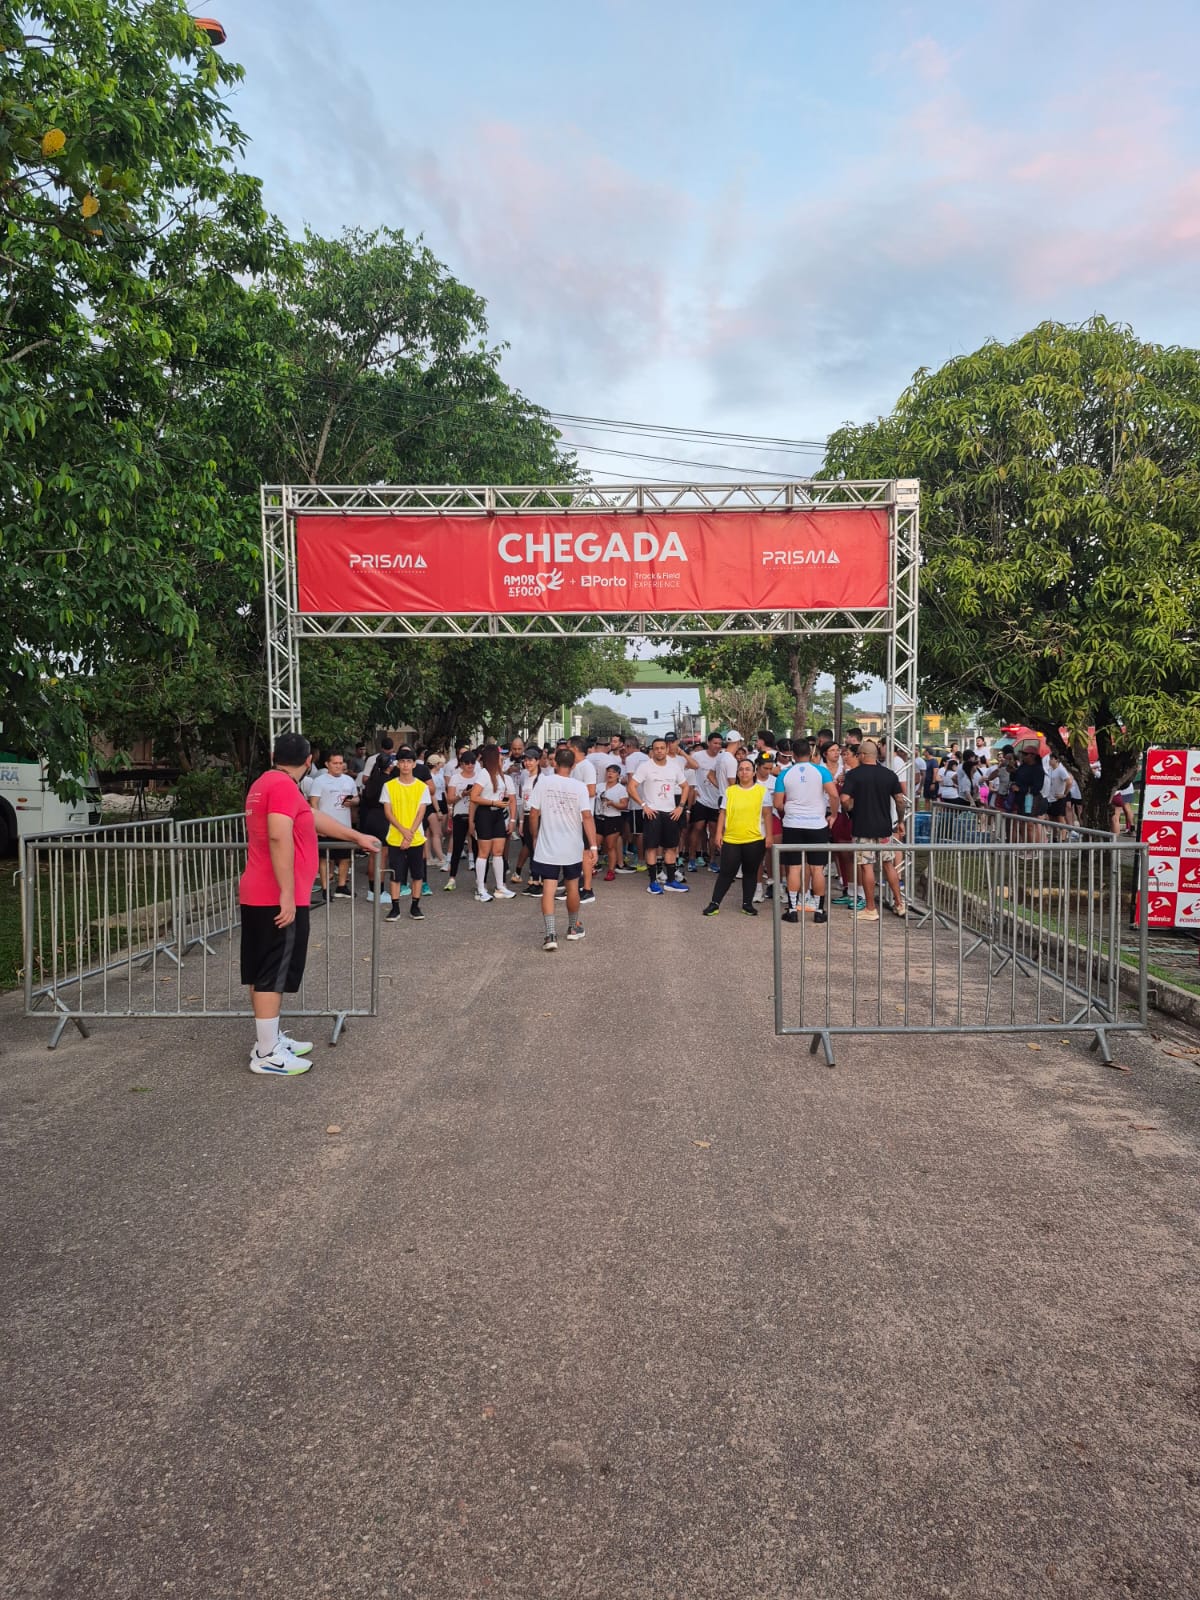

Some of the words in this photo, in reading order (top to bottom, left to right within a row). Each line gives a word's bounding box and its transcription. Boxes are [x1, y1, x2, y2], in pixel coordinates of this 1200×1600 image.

[498, 532, 688, 563] CHEGADA
[349, 554, 428, 568] PRISMA
[762, 549, 840, 565] PRISMA
[504, 575, 535, 586] AMOR
[593, 575, 627, 587] Porto
[515, 586, 541, 597] FOCO
